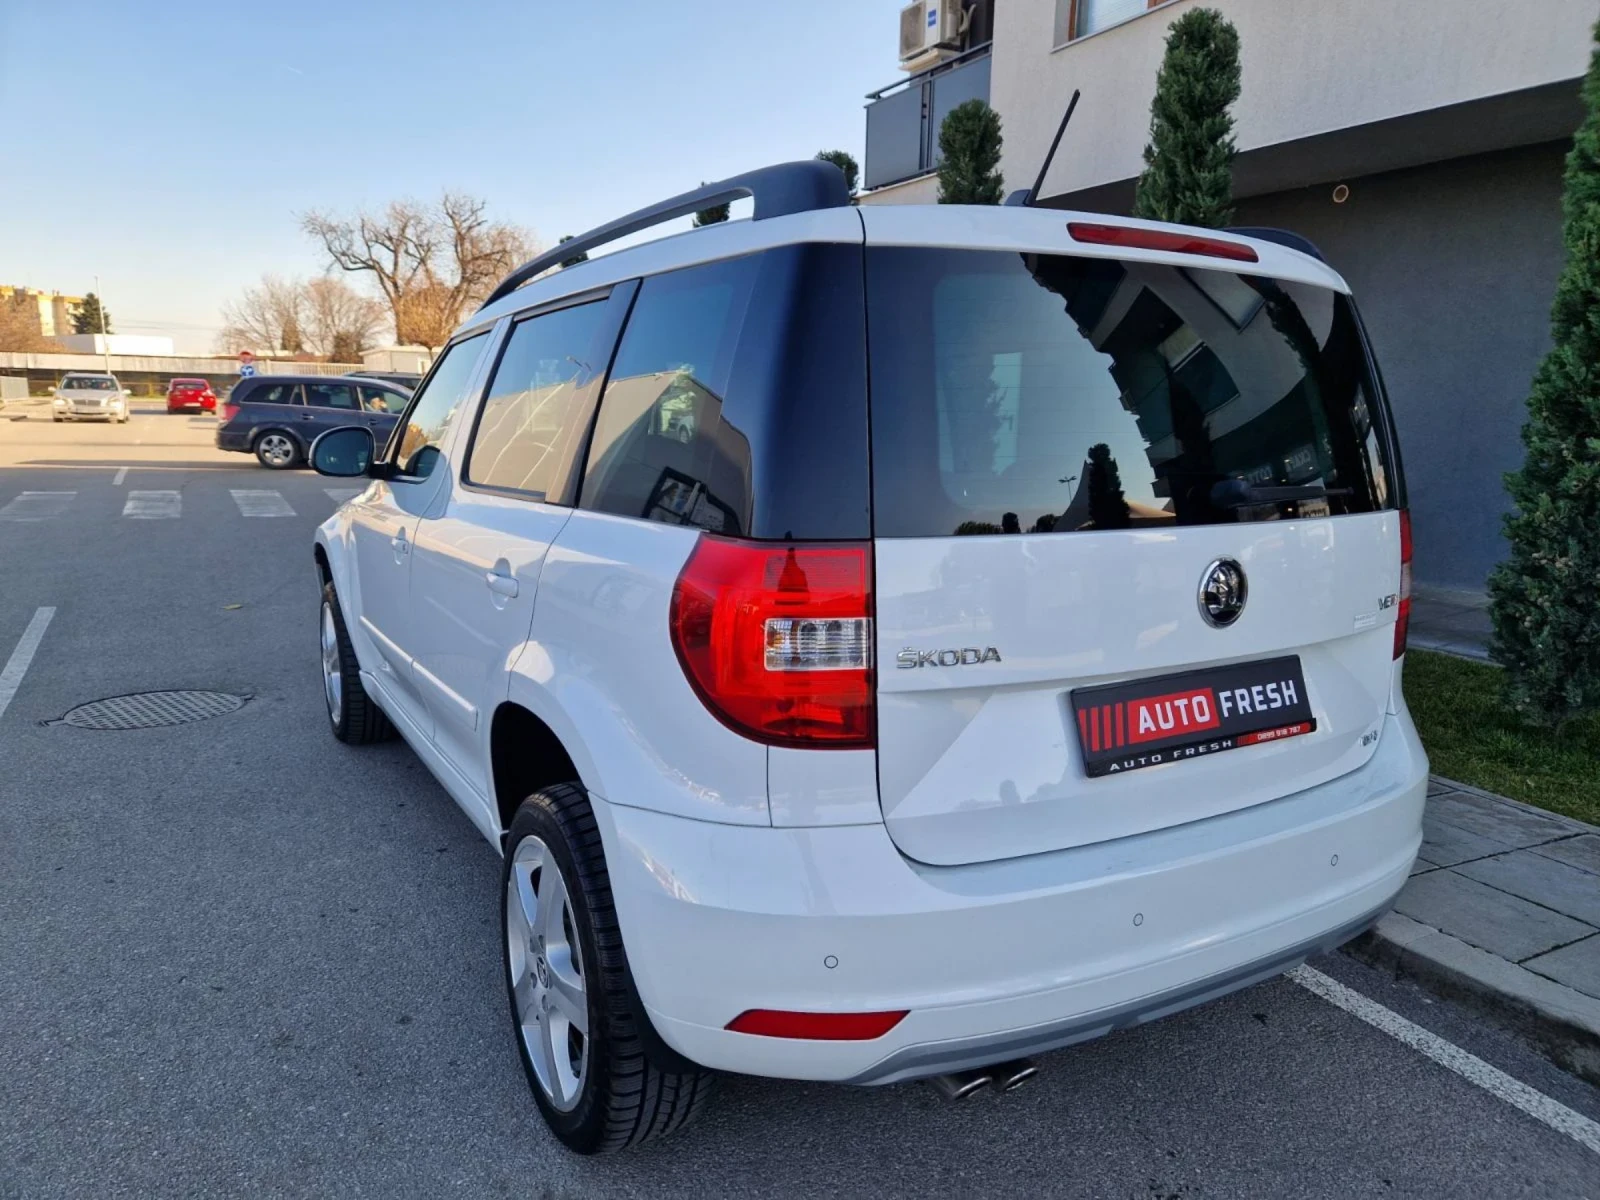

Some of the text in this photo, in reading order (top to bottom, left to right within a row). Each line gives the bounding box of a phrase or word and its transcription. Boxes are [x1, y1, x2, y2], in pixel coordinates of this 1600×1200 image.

[1138, 679, 1299, 734] AUTO FRESH
[1109, 739, 1233, 772] AUTO FRESH
